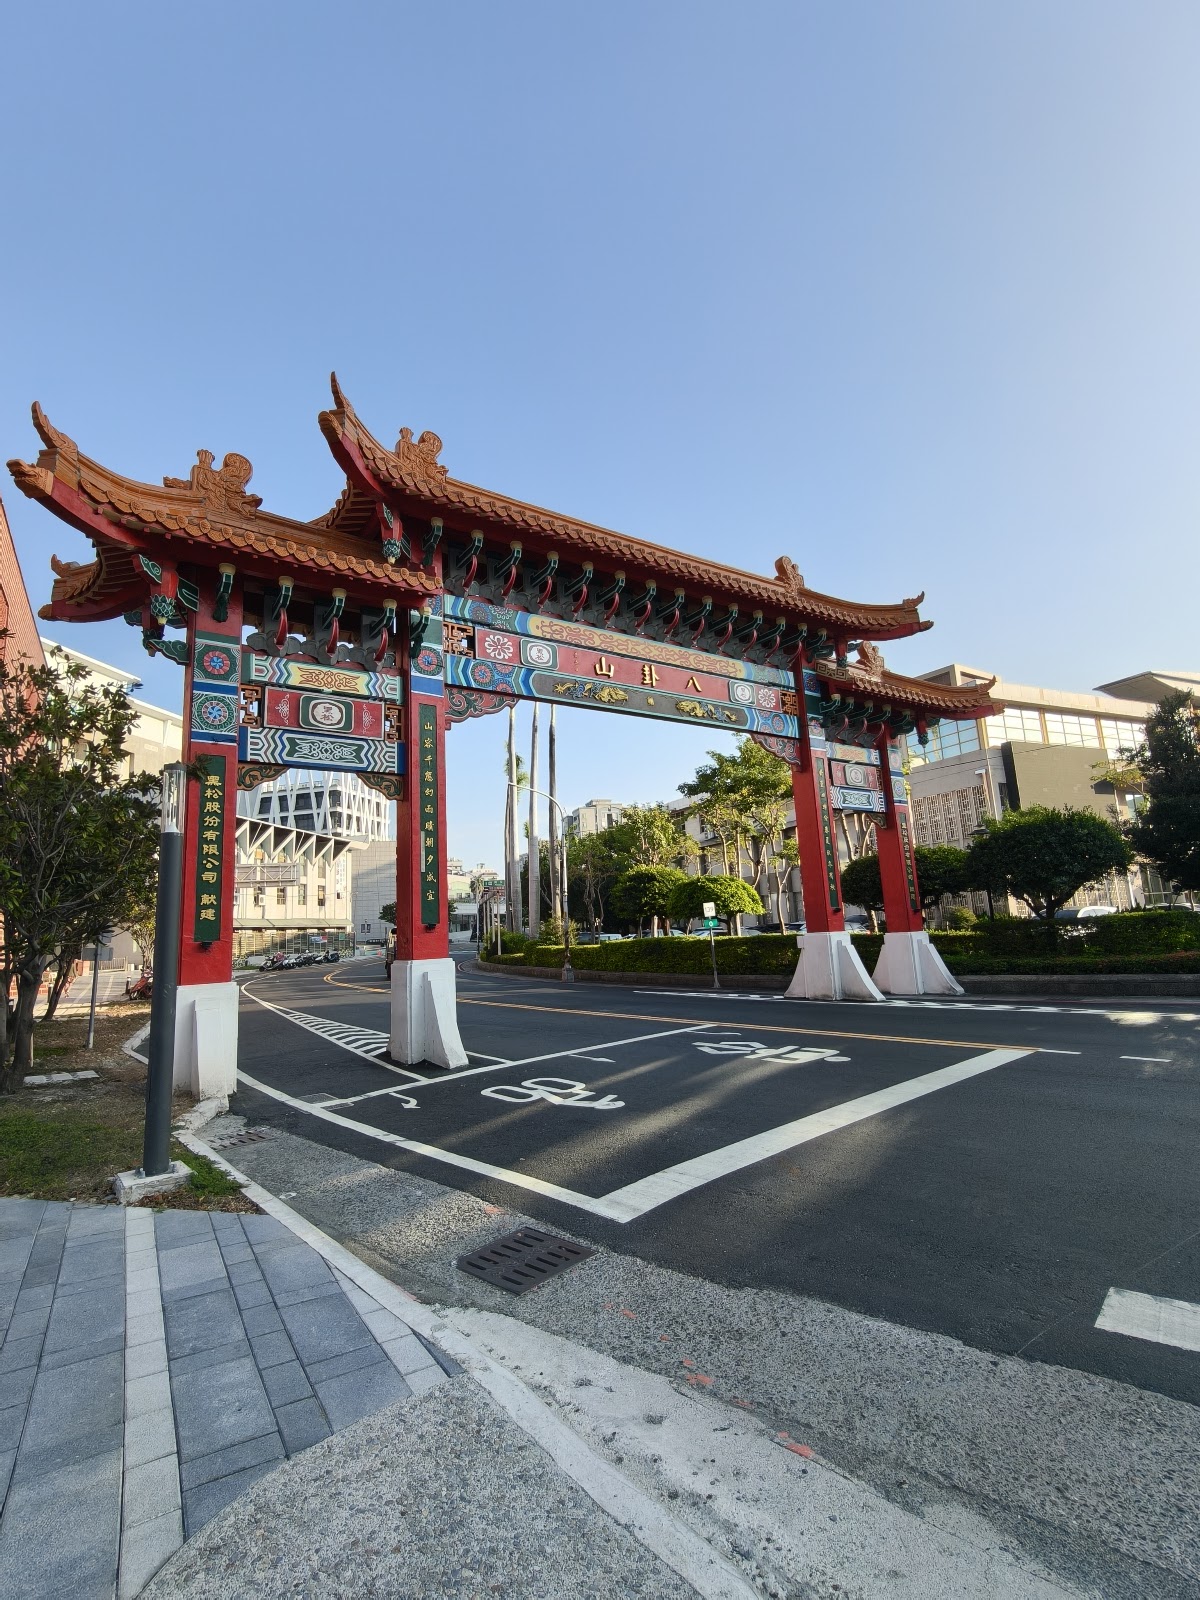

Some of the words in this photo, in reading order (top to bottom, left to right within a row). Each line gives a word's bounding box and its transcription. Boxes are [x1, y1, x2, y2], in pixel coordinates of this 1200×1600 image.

[320, 705, 335, 722] 黑松
[201, 775, 224, 884] 黑松股份有限公司
